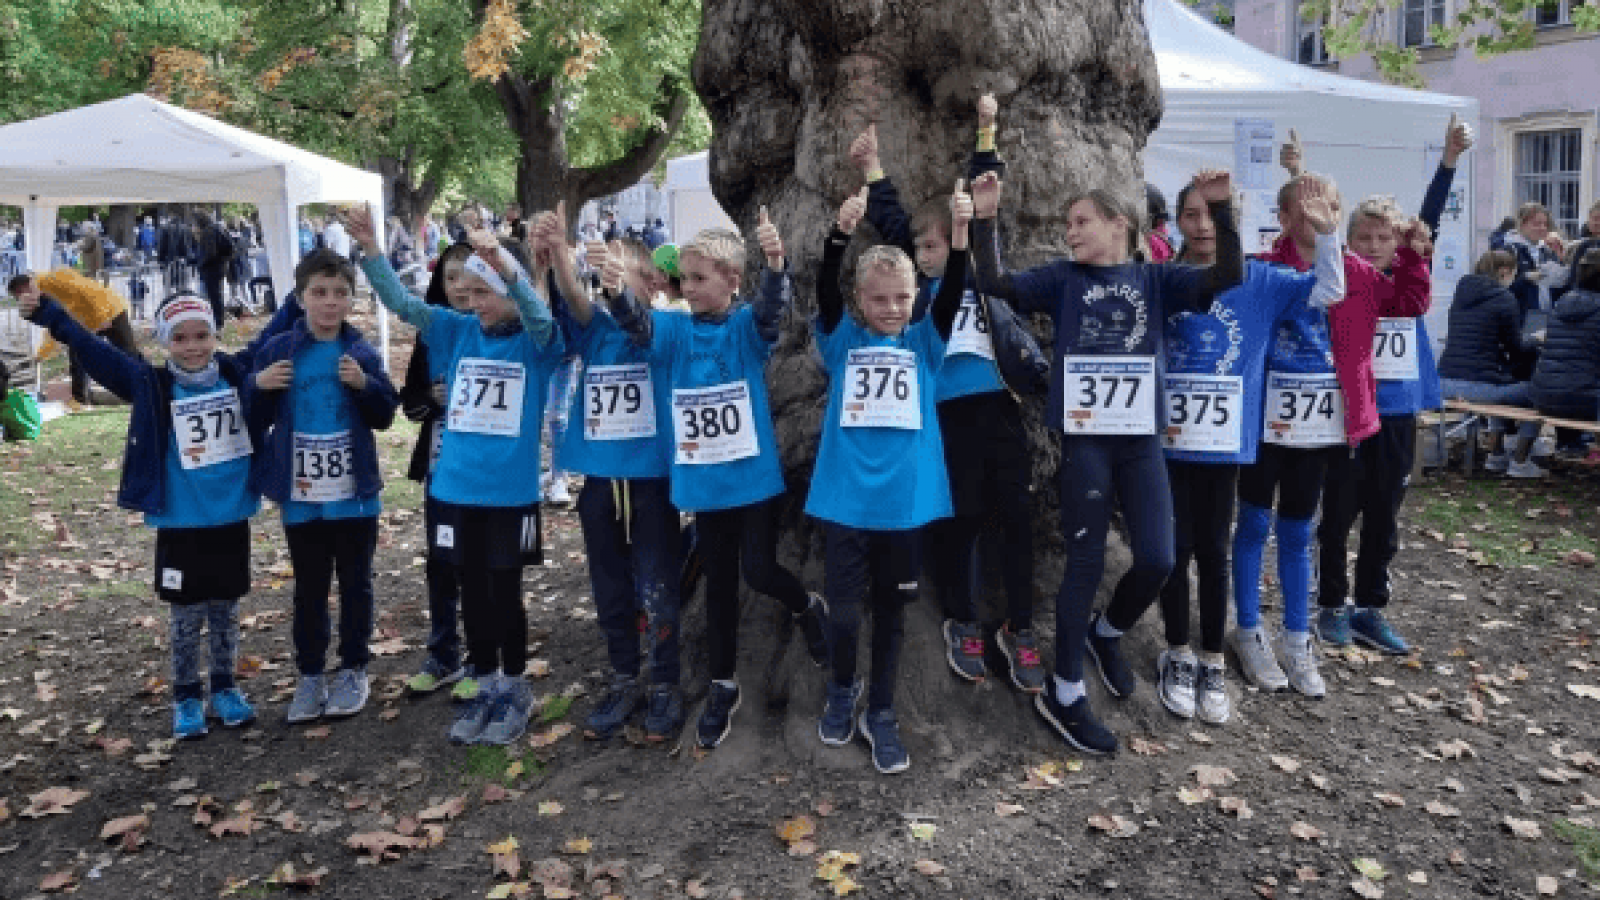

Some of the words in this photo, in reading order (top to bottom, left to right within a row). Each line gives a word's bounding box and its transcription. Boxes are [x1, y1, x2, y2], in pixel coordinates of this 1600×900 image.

[957, 306, 990, 334] 78
[1376, 333, 1406, 357] 70
[458, 377, 509, 412] 371
[590, 384, 641, 416] 379
[855, 367, 908, 401] 376
[1078, 376, 1141, 408] 377
[682, 405, 741, 440] 380
[1169, 394, 1229, 428] 375
[1280, 392, 1334, 421] 374
[186, 407, 240, 443] 372
